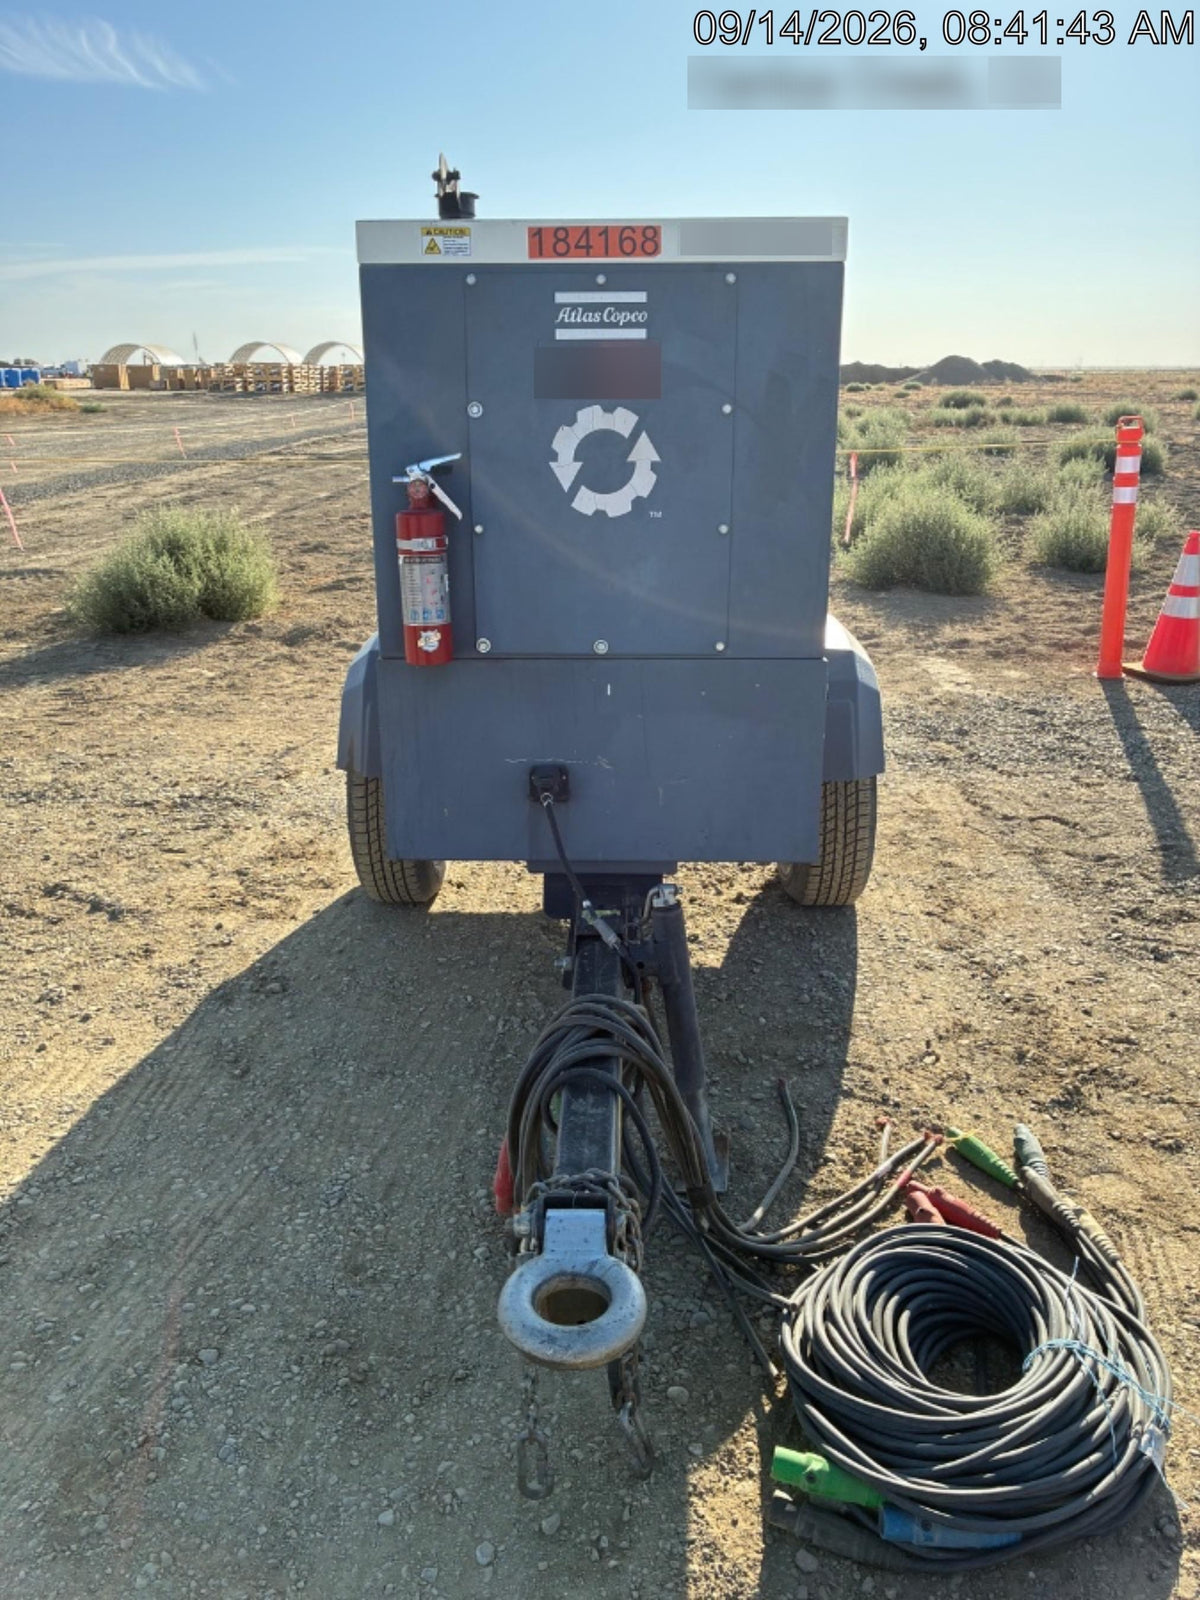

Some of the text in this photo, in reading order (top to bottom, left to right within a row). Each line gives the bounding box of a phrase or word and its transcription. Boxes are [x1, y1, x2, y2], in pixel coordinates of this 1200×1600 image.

[531, 226, 659, 257] 184168
[555, 306, 648, 326] Atlas Copco
